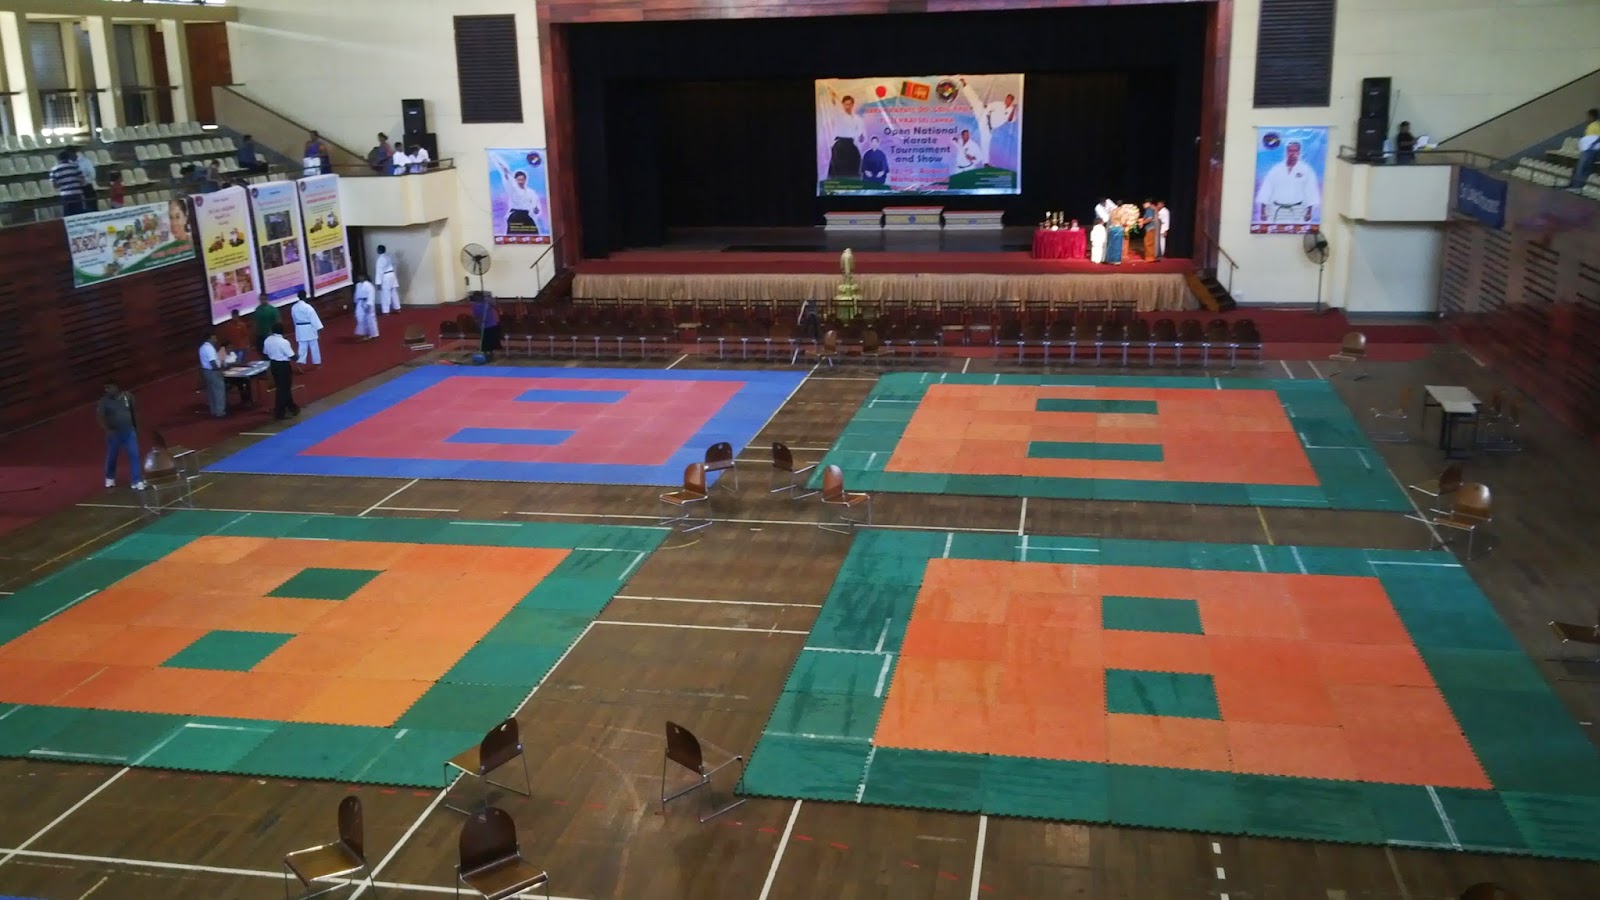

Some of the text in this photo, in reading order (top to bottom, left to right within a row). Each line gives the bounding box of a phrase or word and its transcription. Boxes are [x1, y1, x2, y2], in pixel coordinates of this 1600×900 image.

[883, 126, 958, 136] Open National
[903, 136, 938, 145] Karate
[890, 145, 951, 154] Tournament
[895, 155, 943, 163] and Show
